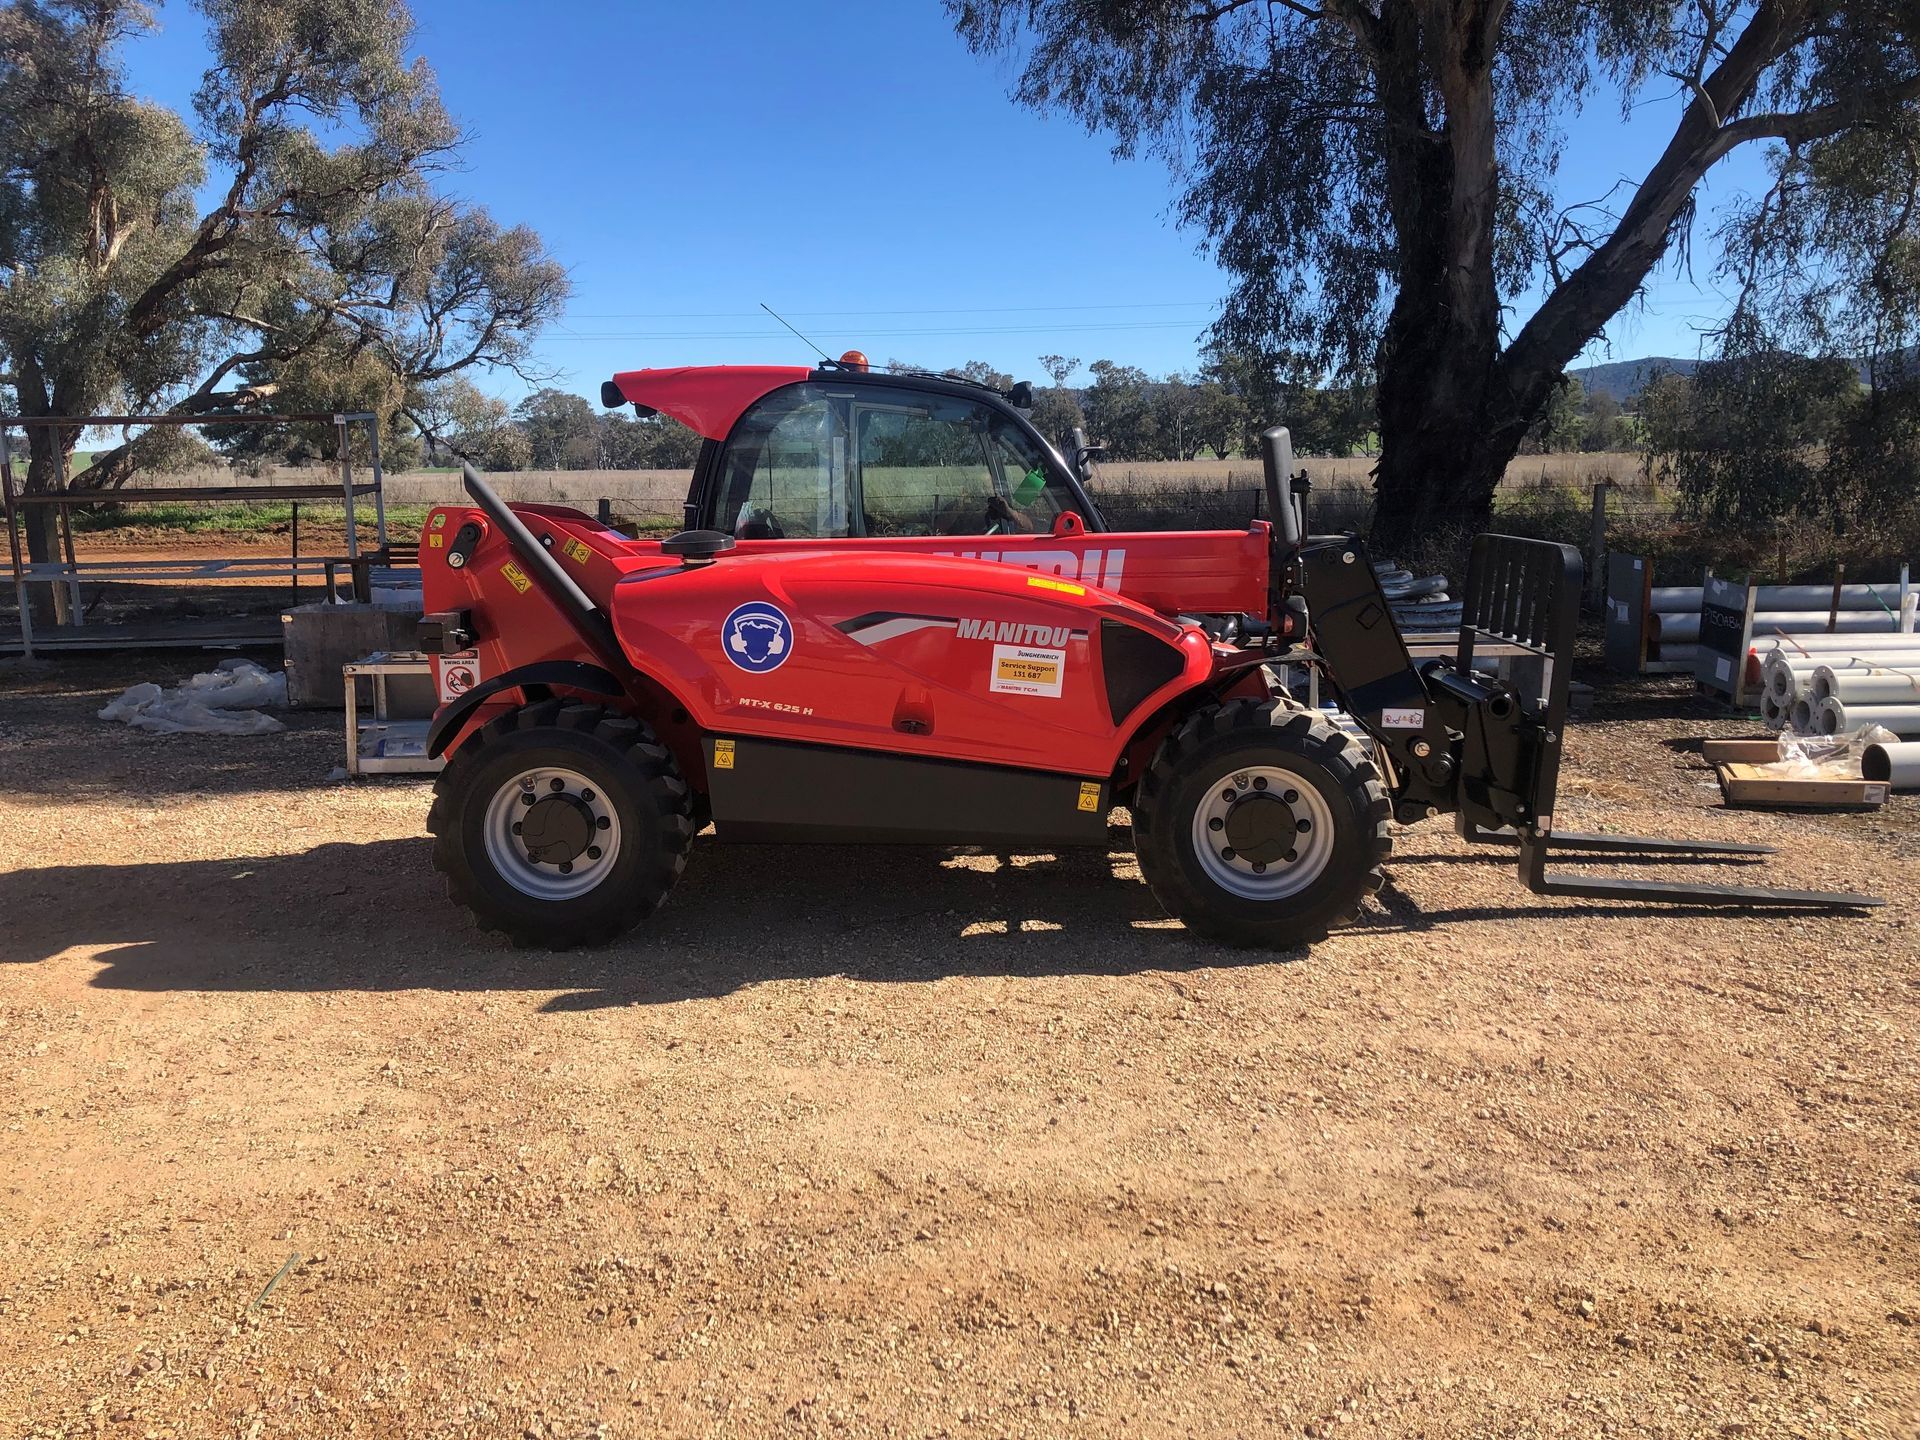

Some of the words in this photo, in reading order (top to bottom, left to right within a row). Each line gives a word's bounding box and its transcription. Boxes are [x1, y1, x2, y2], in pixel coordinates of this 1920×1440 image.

[956, 618, 1070, 647] MANITOU
[1017, 650, 1059, 660] JUNGHEINRICH
[1027, 664, 1055, 672] Support
[739, 698, 772, 708] MT-X
[774, 703, 800, 713] 625
[802, 708, 814, 716] H
